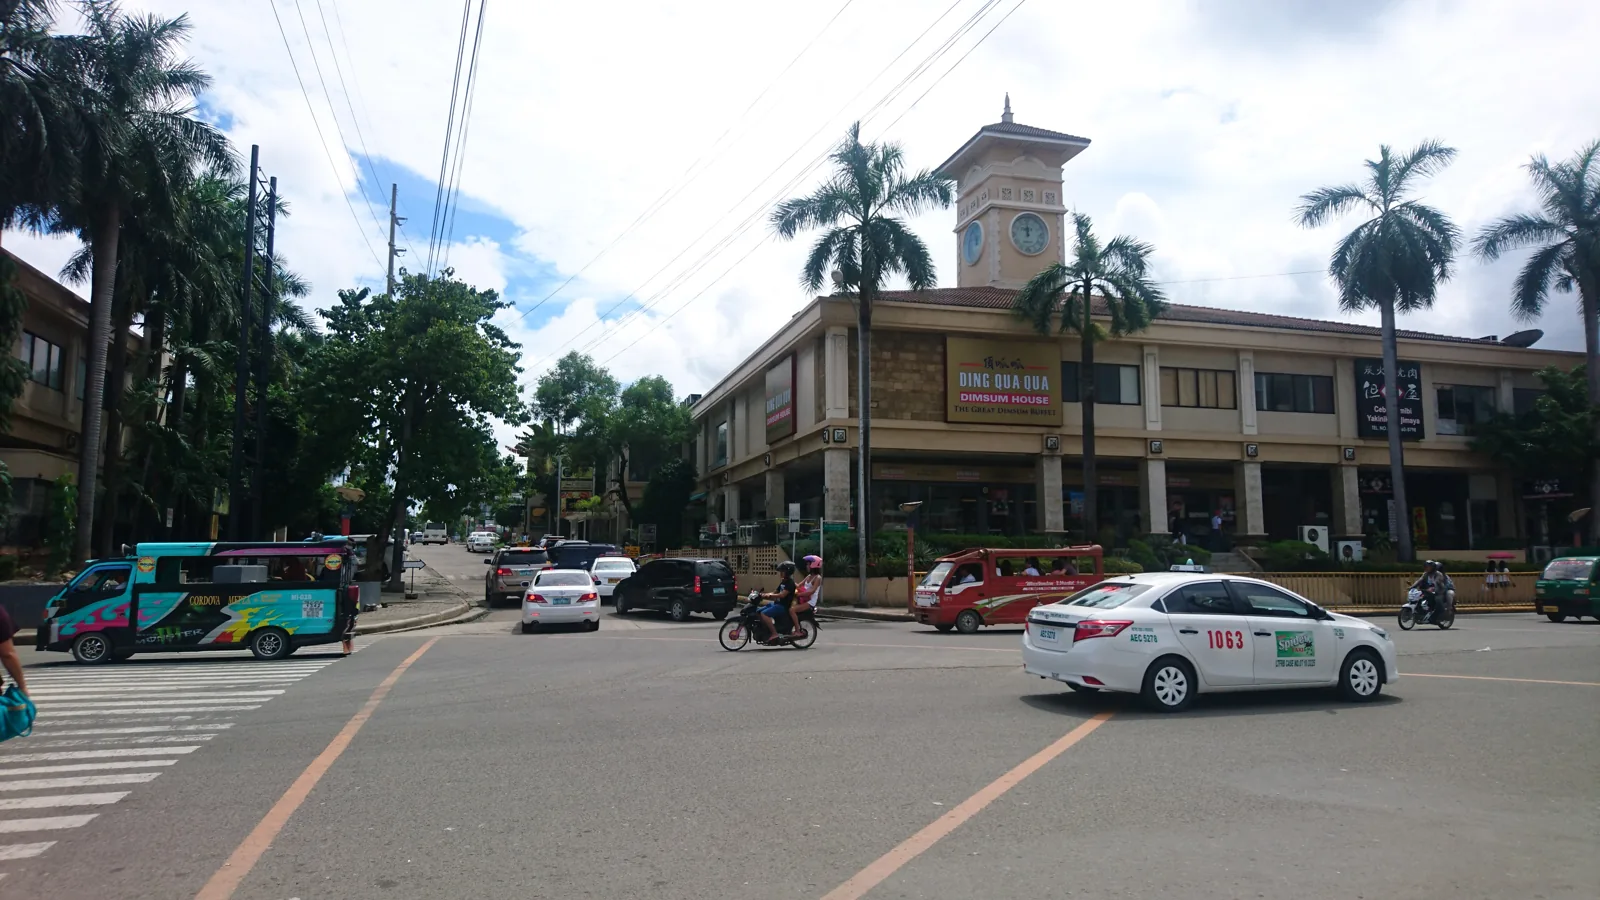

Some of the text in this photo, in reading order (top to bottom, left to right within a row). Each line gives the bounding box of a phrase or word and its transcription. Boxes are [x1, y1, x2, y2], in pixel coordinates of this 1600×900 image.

[959, 372, 1049, 391] DING QUA QUA
[960, 393, 1049, 405] DIMSUM HOUSE
[954, 405, 970, 413] THE
[971, 405, 995, 413] GREAT
[1374, 405, 1387, 413] Ceb
[189, 595, 220, 605] CORDOVA
[1130, 634, 1158, 643] AEC 5278
[1207, 630, 1244, 649] 1063
[1278, 634, 1309, 651] Spider
